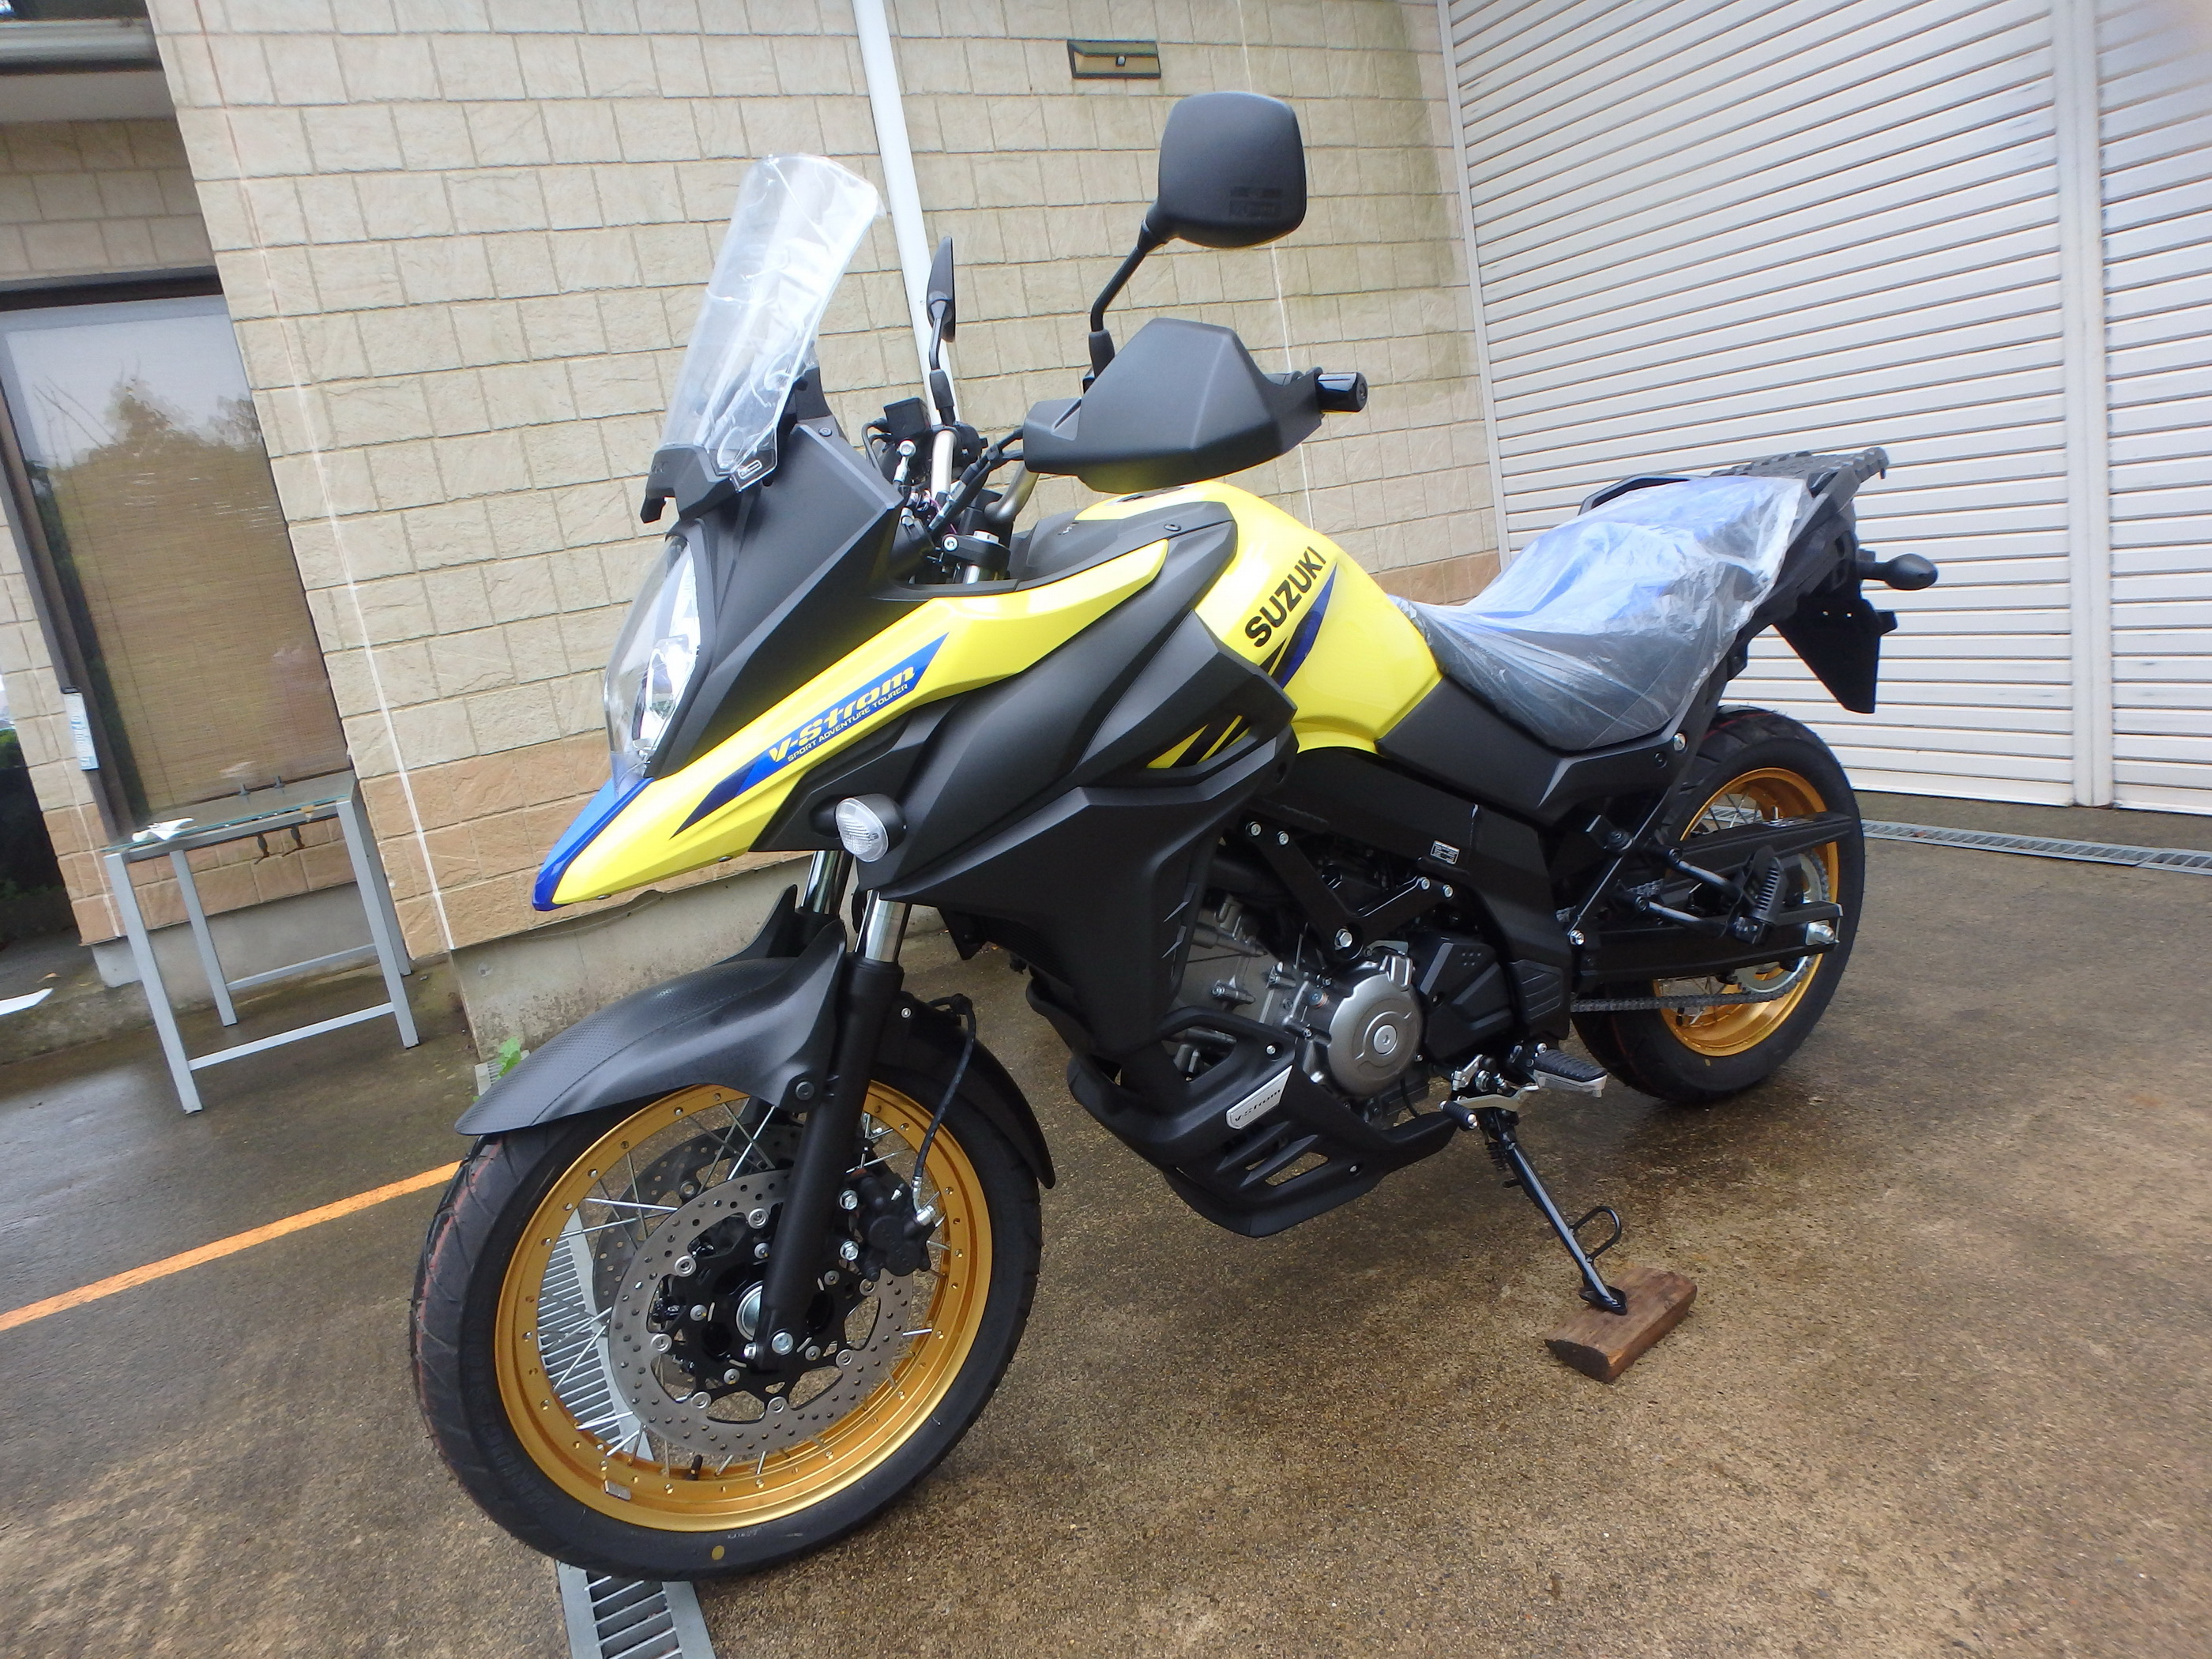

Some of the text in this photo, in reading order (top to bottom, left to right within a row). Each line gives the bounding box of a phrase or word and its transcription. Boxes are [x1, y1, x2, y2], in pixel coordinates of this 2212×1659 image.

[1244, 546, 1326, 648] SUZUKI
[769, 666, 916, 762] V-Strom
[788, 683, 908, 762] SPORT ADVENTURE TOURER
